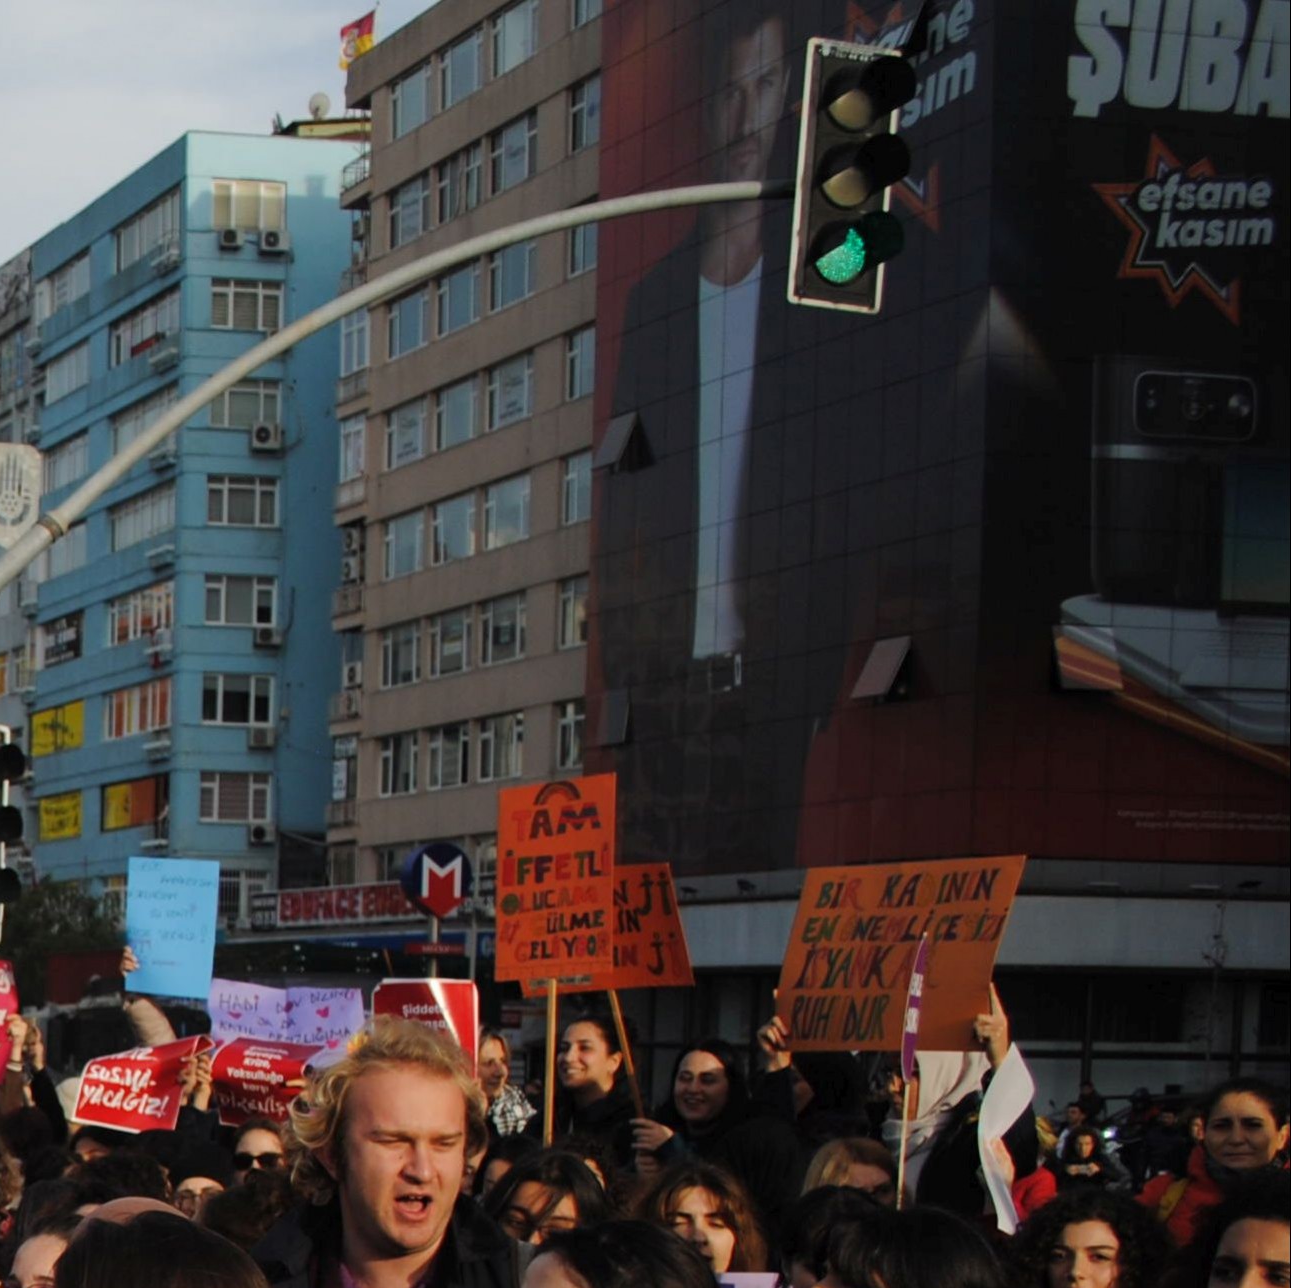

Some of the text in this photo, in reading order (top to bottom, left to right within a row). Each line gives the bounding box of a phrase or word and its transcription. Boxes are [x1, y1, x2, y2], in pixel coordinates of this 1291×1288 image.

[1137, 172, 1273, 212] efsane
[1155, 212, 1274, 248] kasım
[512, 802, 601, 841] TAM
[502, 842, 609, 887] İFFETLİ
[815, 874, 864, 910] BİR
[801, 914, 841, 943] EN
